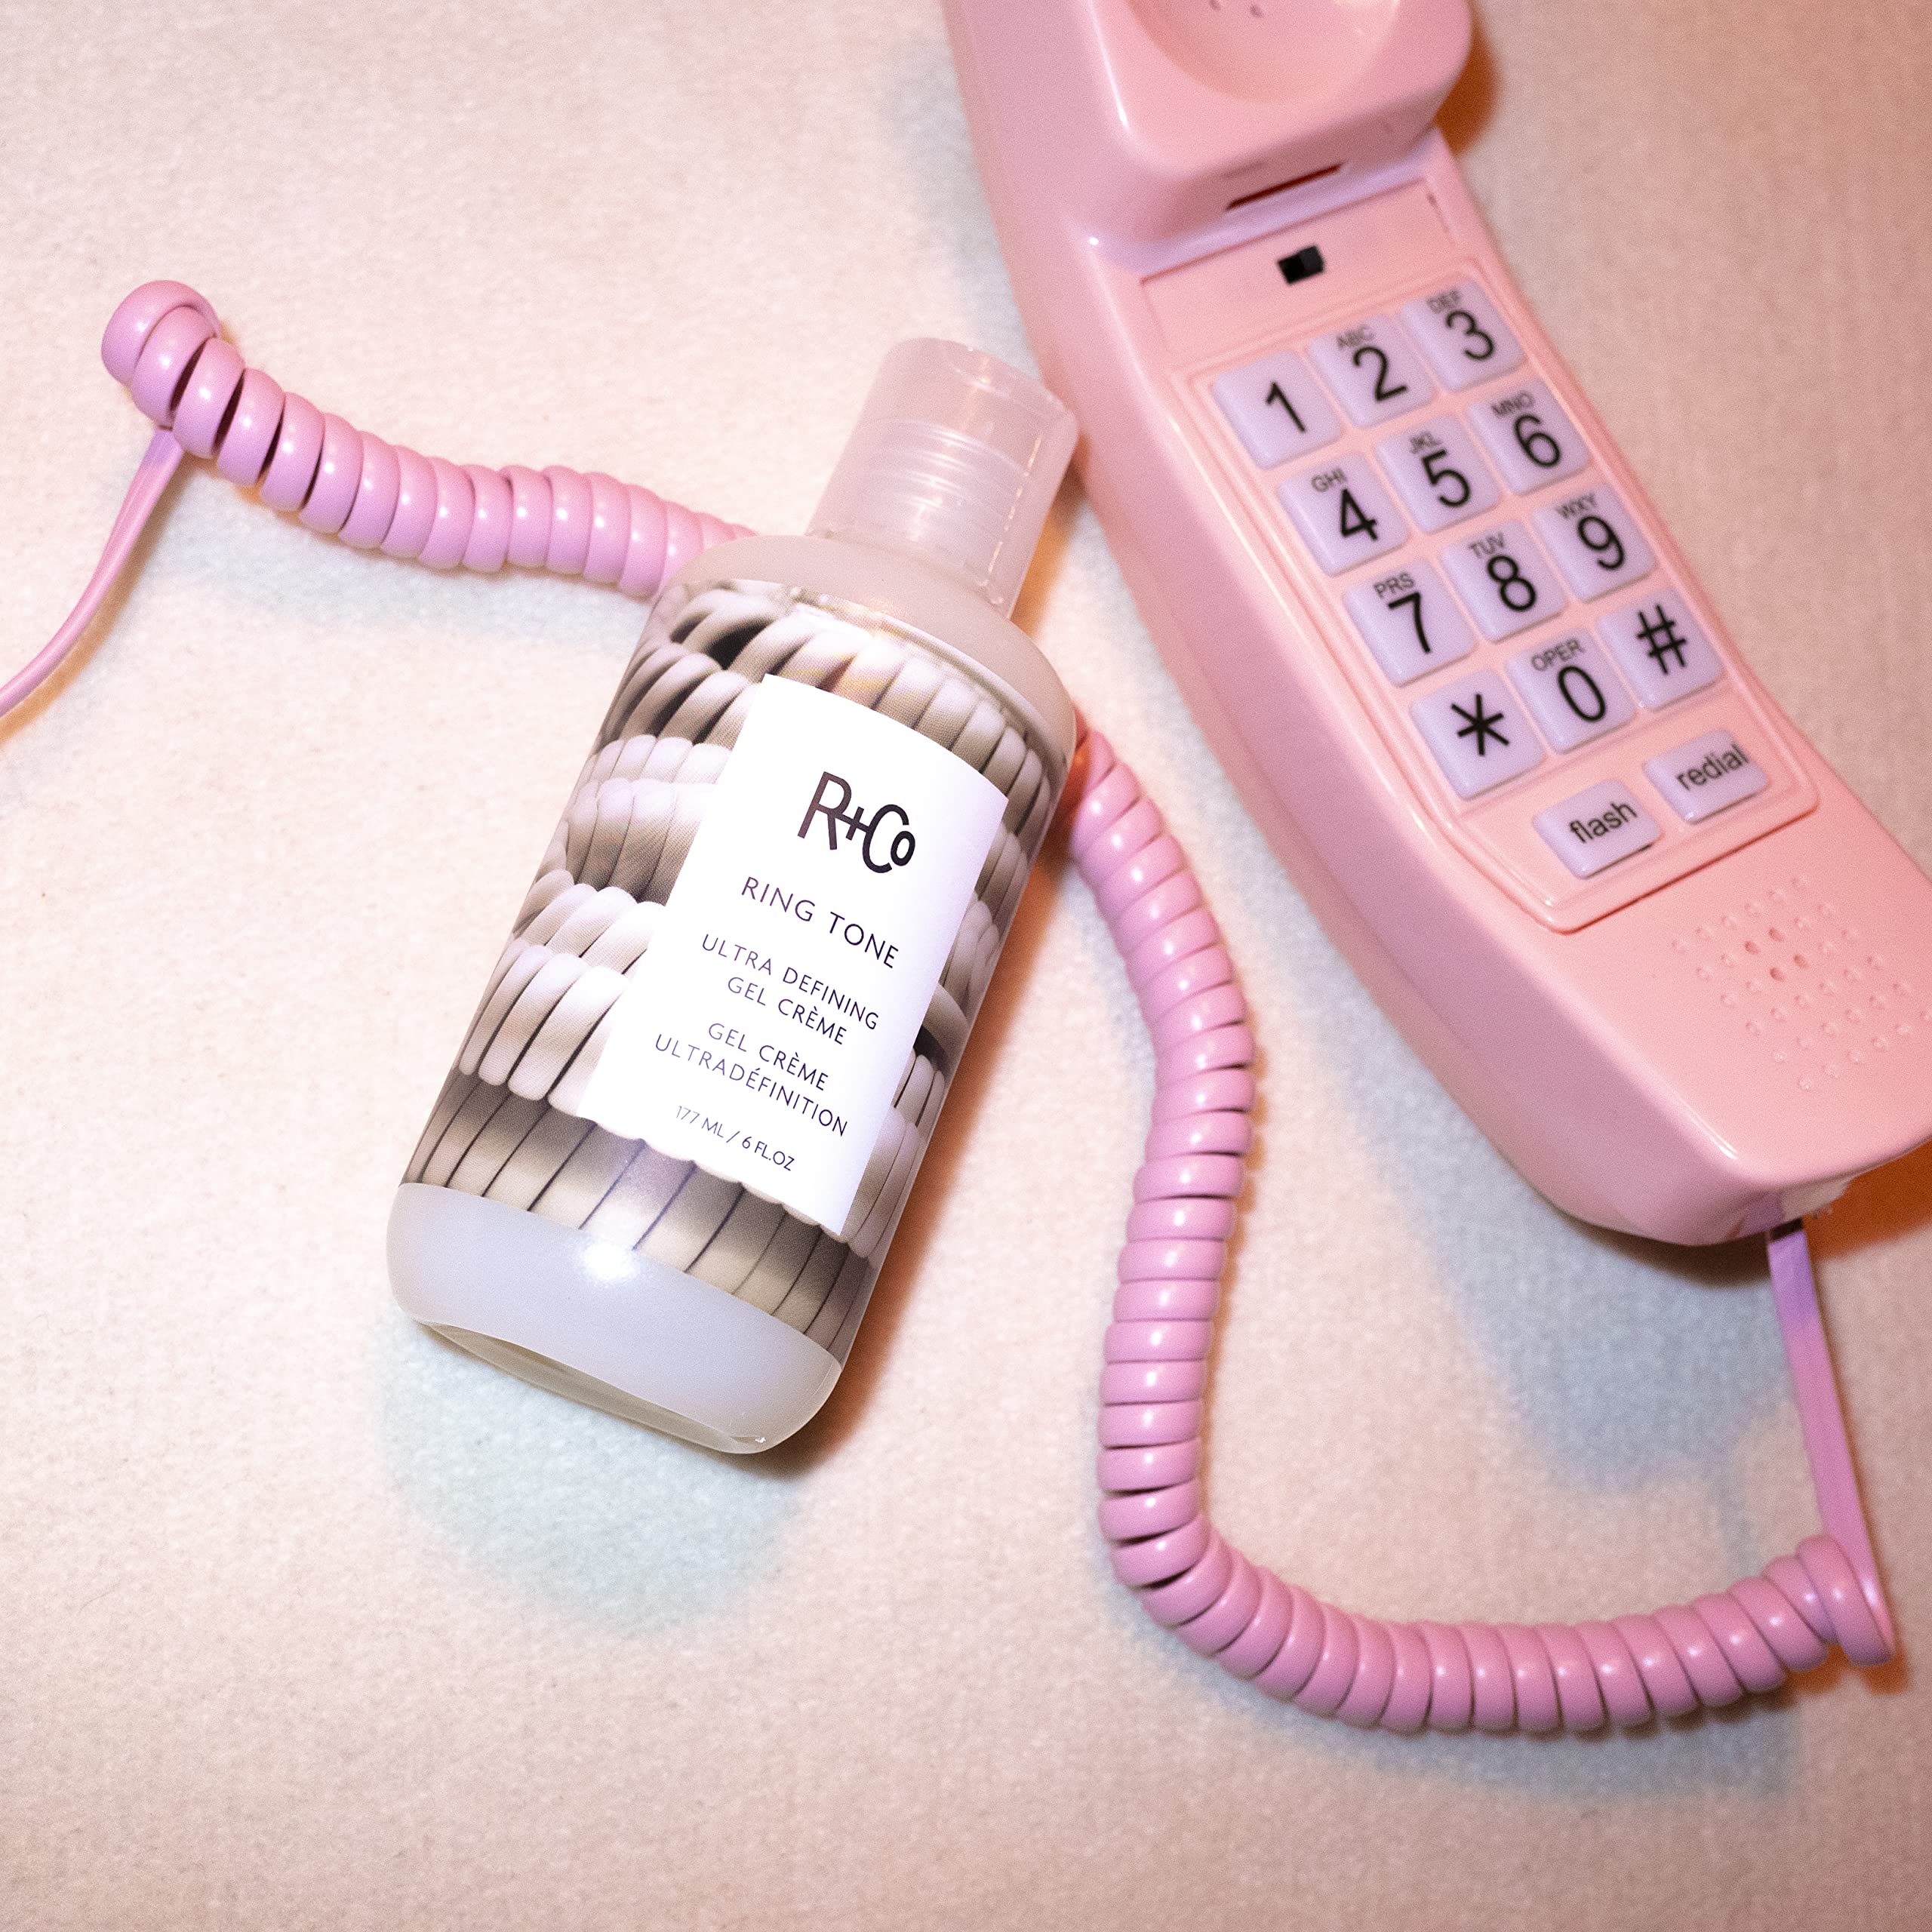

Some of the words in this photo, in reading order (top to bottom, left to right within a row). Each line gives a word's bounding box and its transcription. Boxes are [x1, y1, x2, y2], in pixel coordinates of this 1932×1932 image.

[1444, 309, 1494, 361] 3
[1352, 346, 1407, 402] 2
[1266, 382, 1307, 433] 1
[1491, 392, 1534, 416] MNO
[1514, 413, 1562, 468] 6
[1312, 468, 1346, 491] GHI
[1421, 448, 1471, 508] 5
[1338, 488, 1379, 542] 4
[1577, 515, 1625, 571] 9
[1469, 533, 1506, 557] TUV
[1374, 573, 1414, 597] PRS
[1487, 556, 1537, 612] 8
[1387, 591, 1432, 654] 7
[1531, 639, 1584, 670] OPER
[1557, 665, 1607, 723] 0
[1676, 744, 1749, 792] redial
[797, 771, 915, 874] R+Co
[1569, 801, 1638, 843] flash
[741, 876, 816, 922] RING
[829, 911, 900, 969] TONE
[702, 934, 772, 976] ULTRA
[783, 967, 878, 1030] DEFINING
[728, 977, 766, 1007] GEL
[778, 998, 848, 1045] CRÈME
[708, 1023, 747, 1053] GEL
[758, 1044, 829, 1091] CRÈME
[655, 1034, 848, 1137] ULTRADÉFINITION
[676, 1105, 700, 1124] 177
[701, 1117, 724, 1138] ML
[742, 1136, 752, 1149] 6
[754, 1141, 795, 1171] FL.OZ
